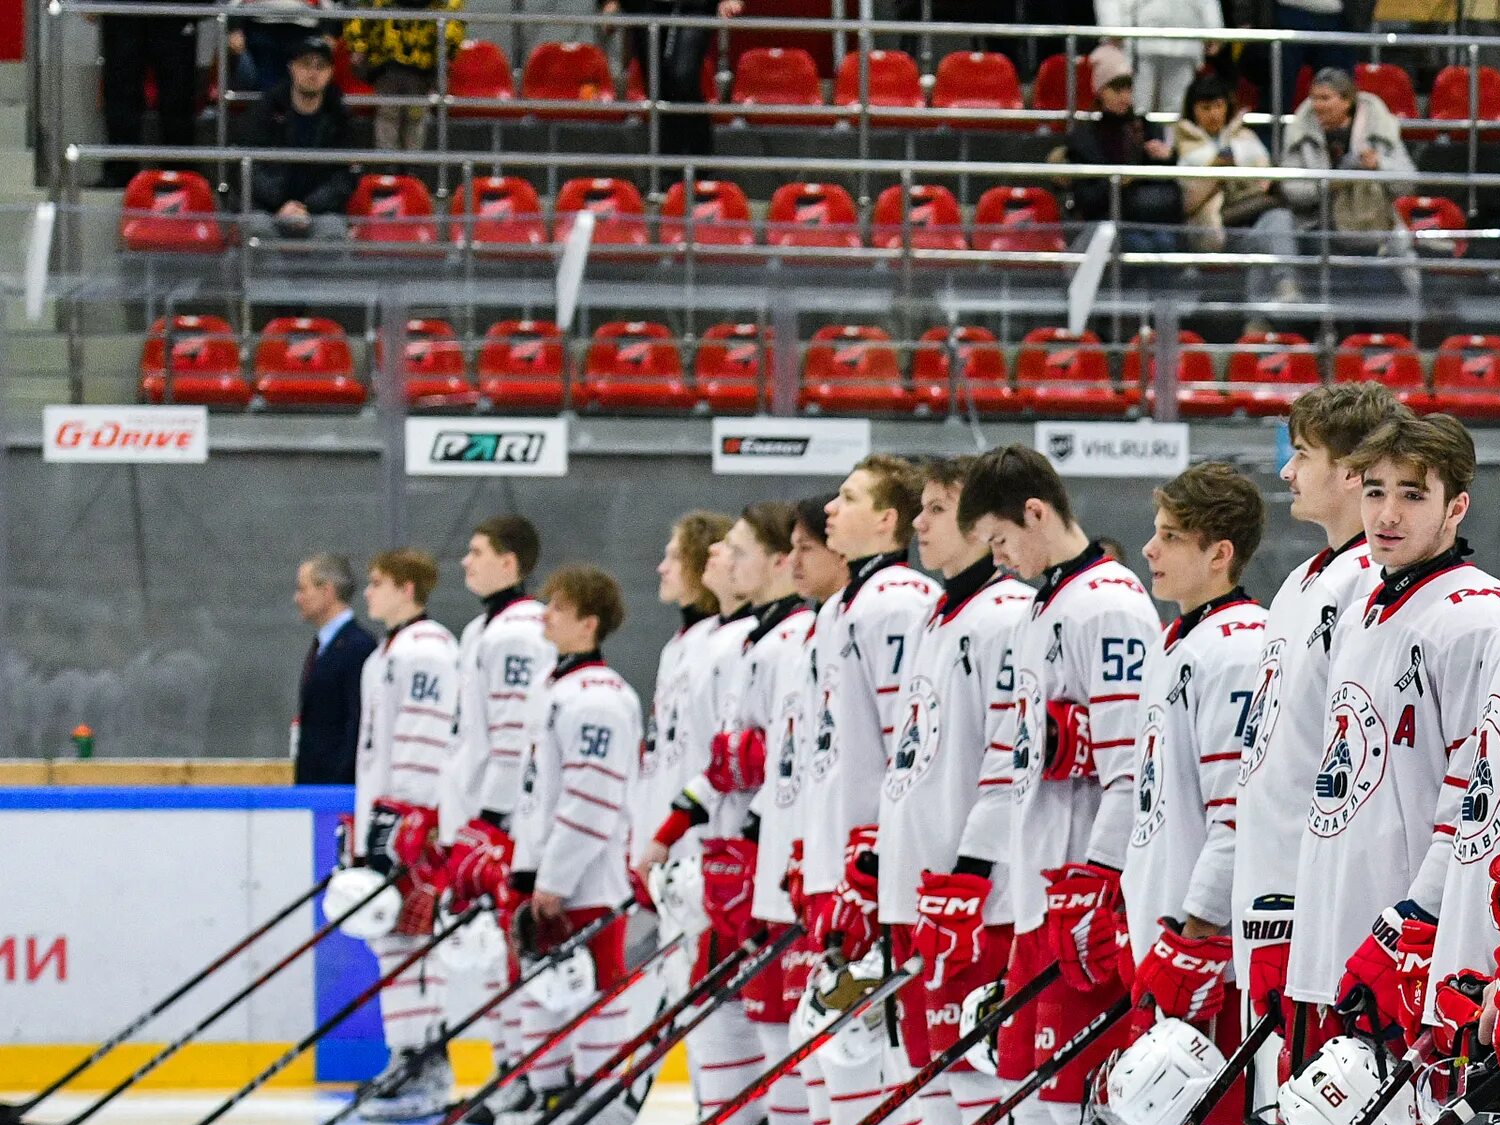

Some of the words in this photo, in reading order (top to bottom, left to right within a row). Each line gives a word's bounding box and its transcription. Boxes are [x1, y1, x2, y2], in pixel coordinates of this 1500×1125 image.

[431, 431, 545, 463] PARI
[1102, 637, 1146, 682] 52
[410, 671, 441, 704] 84
[1393, 704, 1415, 748] A
[1154, 939, 1228, 974] CCM
